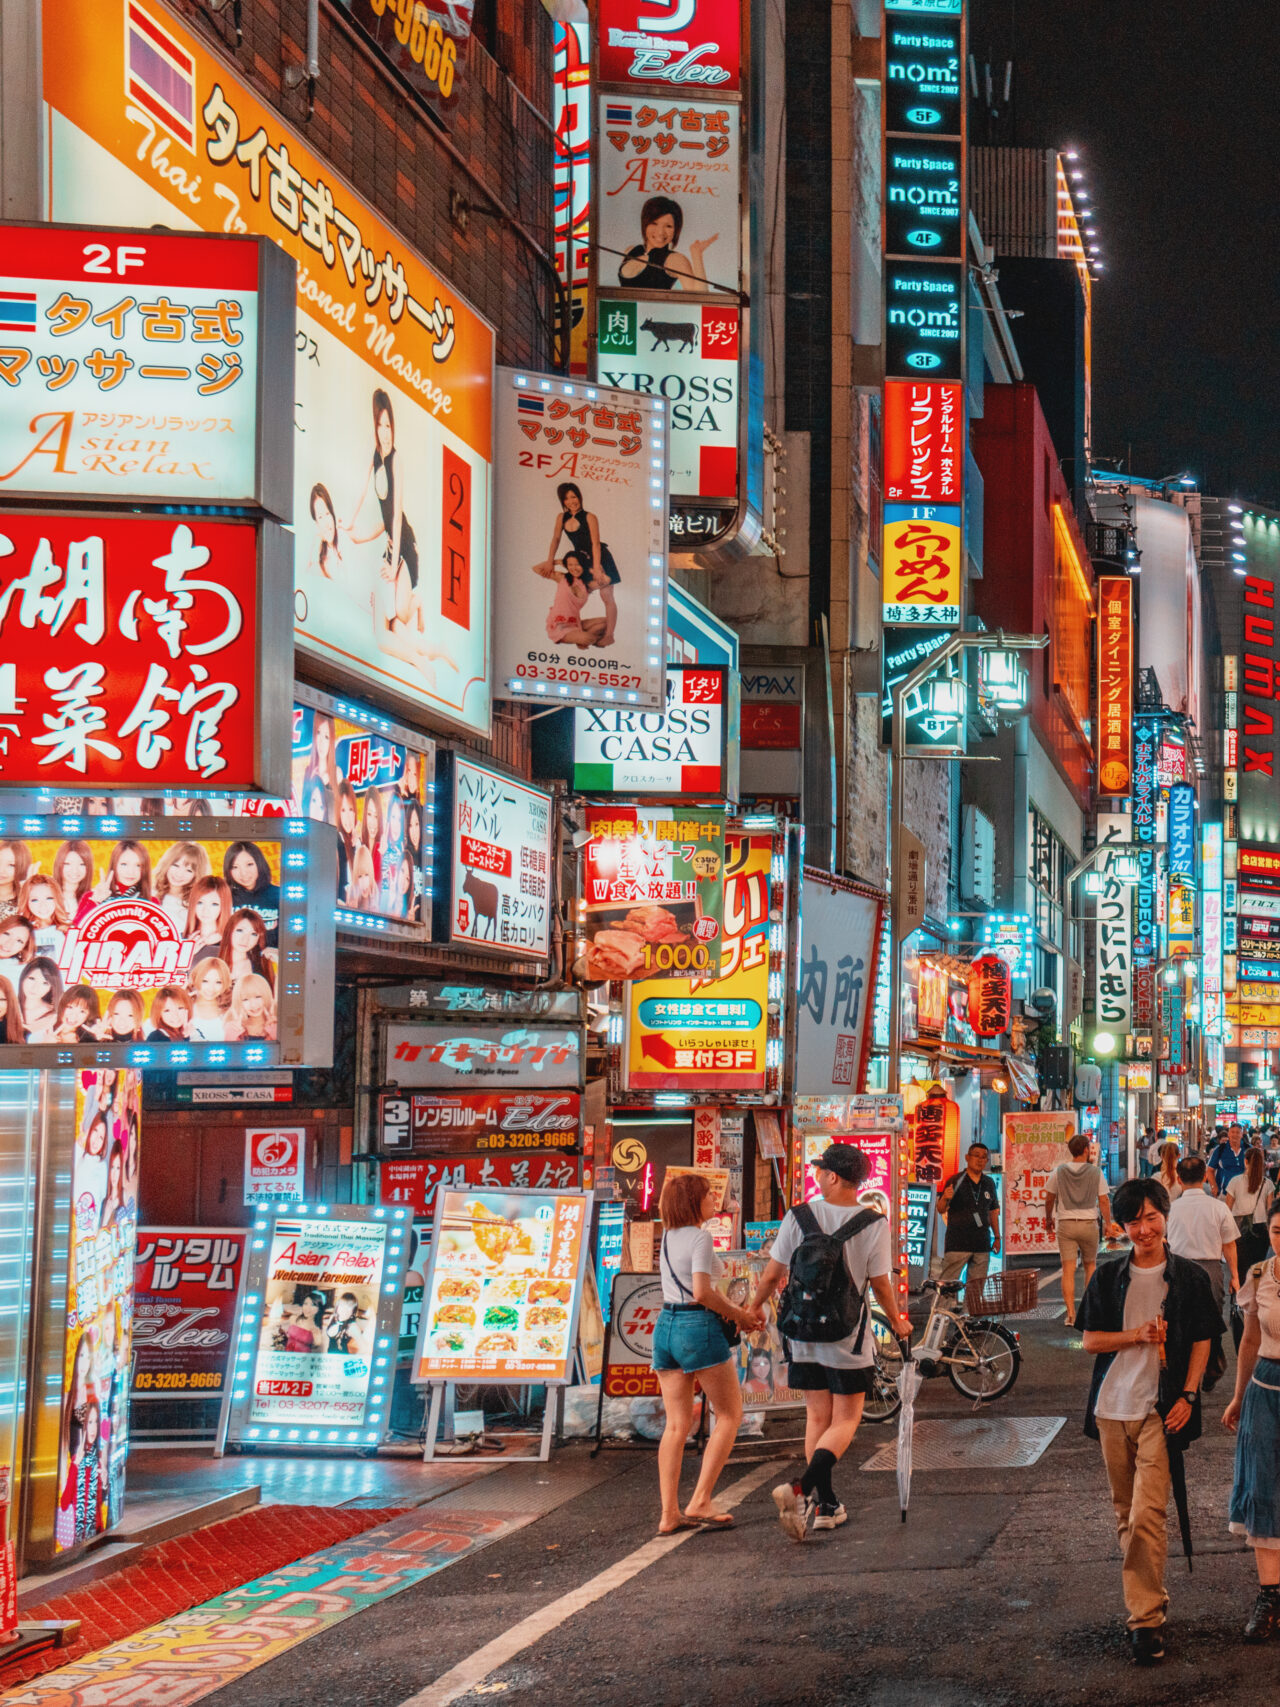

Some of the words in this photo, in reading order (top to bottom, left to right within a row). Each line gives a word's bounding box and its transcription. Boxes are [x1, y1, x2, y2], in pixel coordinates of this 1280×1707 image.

[894, 34, 921, 48] Party
[922, 36, 954, 48] Space
[629, 43, 731, 84] Eden
[635, 107, 730, 134] タイ古式
[915, 110, 933, 122] 5F
[606, 130, 730, 158] マッサージ
[895, 157, 921, 170] Party
[922, 159, 954, 171] Space
[652, 181, 720, 197] Relax
[920, 206, 940, 216] SINCE
[202, 84, 455, 362] タイ古式マッサージ
[915, 233, 933, 245] 4F
[83, 244, 146, 276] 2F
[895, 279, 921, 292] Party
[922, 281, 954, 293] Space
[46, 292, 244, 347] タイ古式
[607, 311, 629, 332] 肉
[703, 321, 737, 334] イタリ
[602, 333, 634, 346] バル
[707, 334, 732, 345] アン
[920, 328, 940, 337] SINCE
[0, 347, 244, 397] マッサージ
[82, 412, 236, 434] アジアンリラックス
[548, 399, 642, 434] タイ古式
[940, 387, 953, 453] レンタルルーム
[518, 419, 642, 456] マッサージ
[910, 386, 932, 499] リフレッシュ
[82, 454, 214, 481] Relax
[940, 458, 953, 496] ホステル
[888, 487, 903, 498] 2F
[911, 507, 936, 520] 1F
[894, 524, 951, 603] らーめん
[886, 607, 958, 622] 博多天神
[527, 651, 560, 665] 60分
[516, 663, 642, 689] 03-3207-5527
[685, 676, 720, 690] イタリ
[1107, 600, 1121, 750] 個室ダイニング居酒屋
[689, 690, 715, 702] アン
[584, 707, 711, 734] XROSS
[927, 720, 945, 731] B1
[600, 736, 699, 762] CASA
[458, 772, 517, 806] ヘルシー
[458, 802, 502, 840] 肉バル
[590, 820, 721, 842] 肉祭り開催中
[1172, 787, 1192, 858] カラオケ
[619, 862, 665, 878] 生ハム
[1172, 860, 1191, 872] 747
[1226, 883, 1234, 908] SEGA
[501, 893, 545, 923] 高タンパク
[500, 918, 544, 947] 低カロリー
[1100, 824, 1127, 1024] とんかつにいむら
[1204, 896, 1217, 970] カラオケ
[1226, 921, 1234, 946] SEGA
[1242, 1011, 1266, 1022] ゲーム
[675, 1050, 753, 1068] 受付3F
[193, 1091, 229, 1100] XROSS
[246, 1091, 274, 1100] CASA
[415, 1107, 497, 1128] レンタルルーム
[500, 1098, 578, 1131] Eden
[489, 1132, 575, 1148] 03-3203-9666
[251, 1181, 297, 1192] すてるな
[274, 1241, 330, 1267] Asian
[332, 1251, 379, 1268] Relax
[151, 1264, 234, 1290] ルーム
[136, 1372, 222, 1389] 03-3203-9666
[258, 1380, 310, 1395] 当ビル2F
